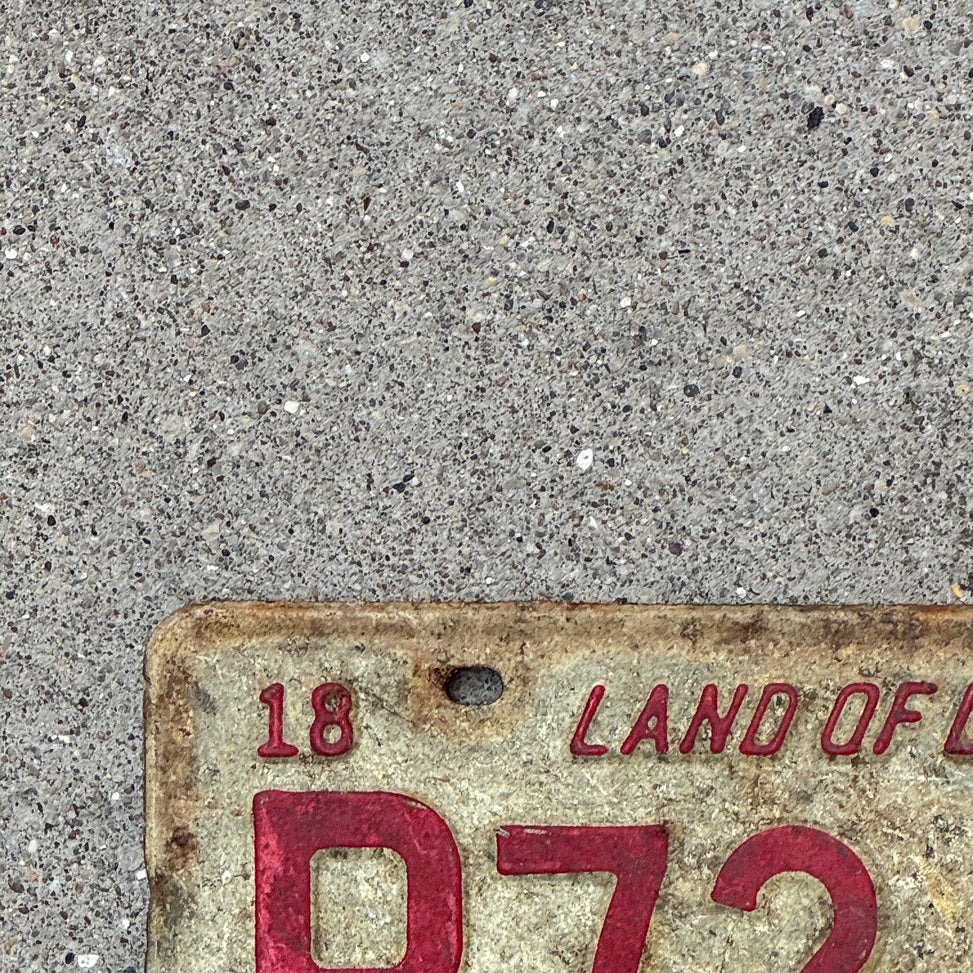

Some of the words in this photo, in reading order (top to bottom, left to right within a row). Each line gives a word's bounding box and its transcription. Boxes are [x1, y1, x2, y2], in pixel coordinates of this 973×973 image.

[258, 683, 355, 757] 18
[570, 683, 799, 757] LAND
[821, 682, 937, 757] OF
